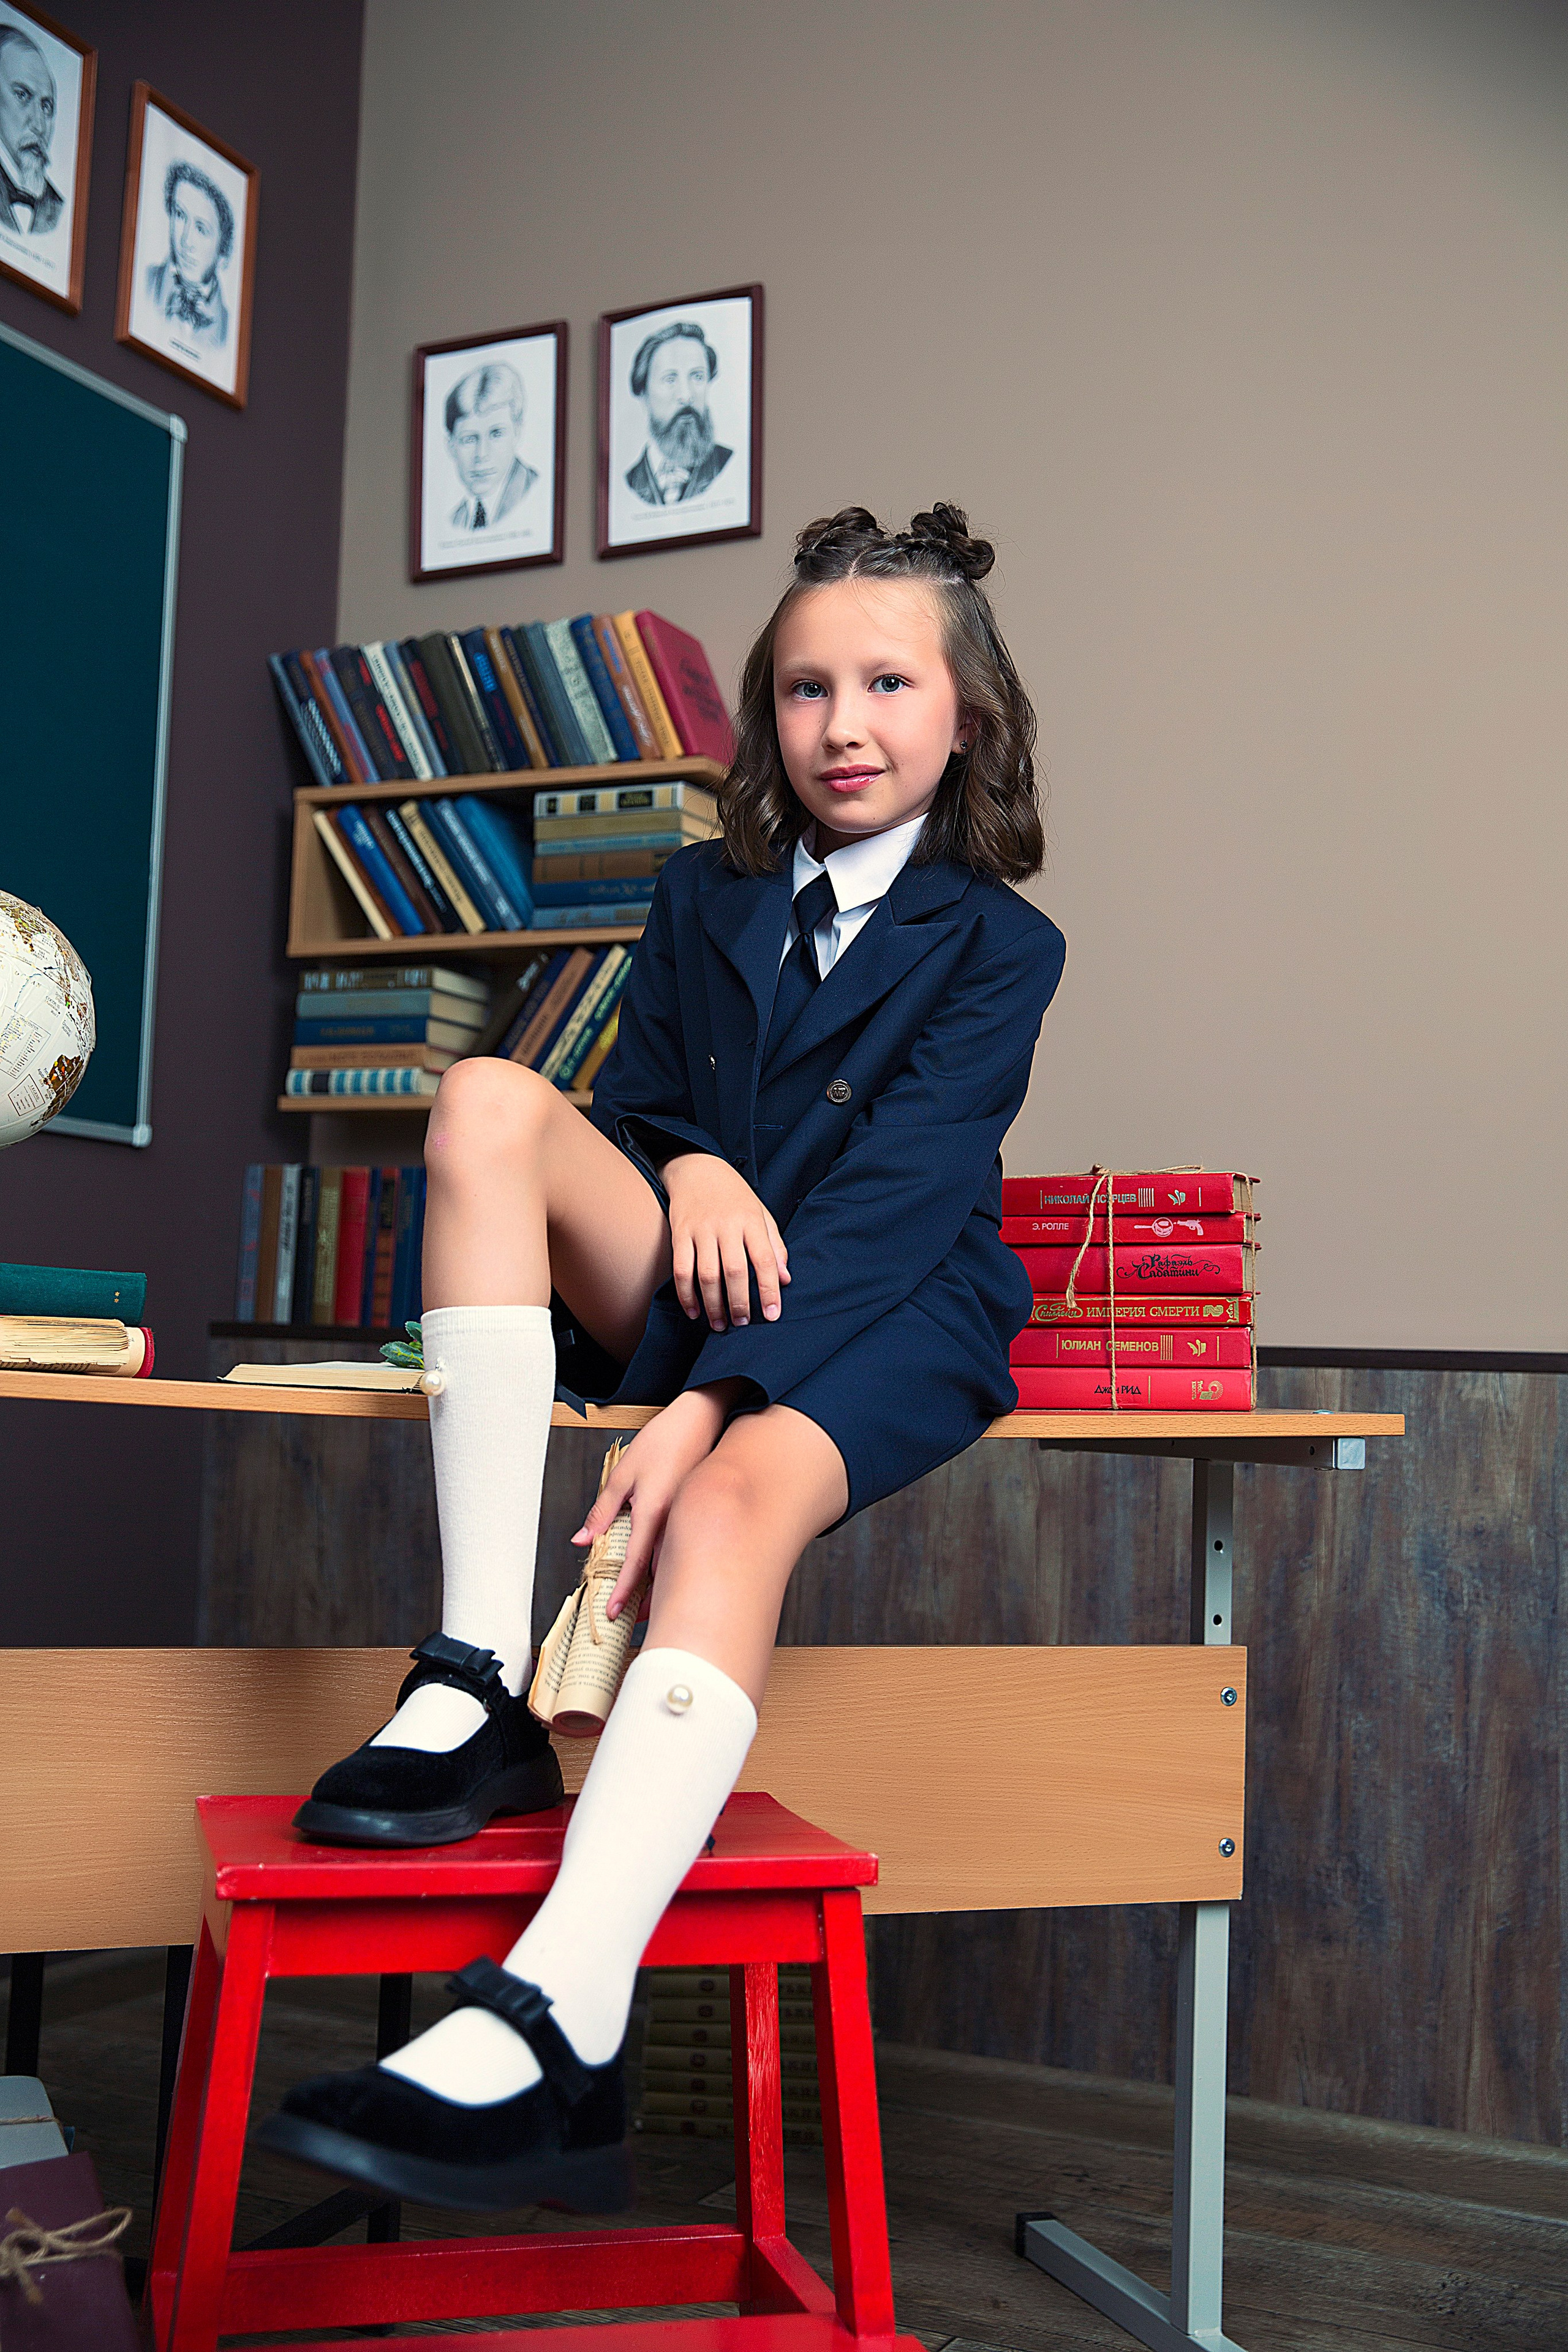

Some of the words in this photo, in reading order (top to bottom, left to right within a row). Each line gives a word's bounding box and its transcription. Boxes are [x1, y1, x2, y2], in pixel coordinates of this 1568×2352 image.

[1044, 1194, 1090, 1204] НИКОЛАЙ
[1094, 1194, 1137, 1204] ПСРЦЕВ
[1140, 1254, 1193, 1268] Рафаэль
[1134, 1263, 1204, 1280] Сабатини
[1087, 1306, 1146, 1317] ИМПЕРИЯ
[1150, 1306, 1200, 1317] СМЕРТИ
[1061, 1340, 1101, 1351] ЮЛИАН
[1106, 1341, 1159, 1351] СЕМЕНОВ
[1121, 1385, 1142, 1395] РИД
